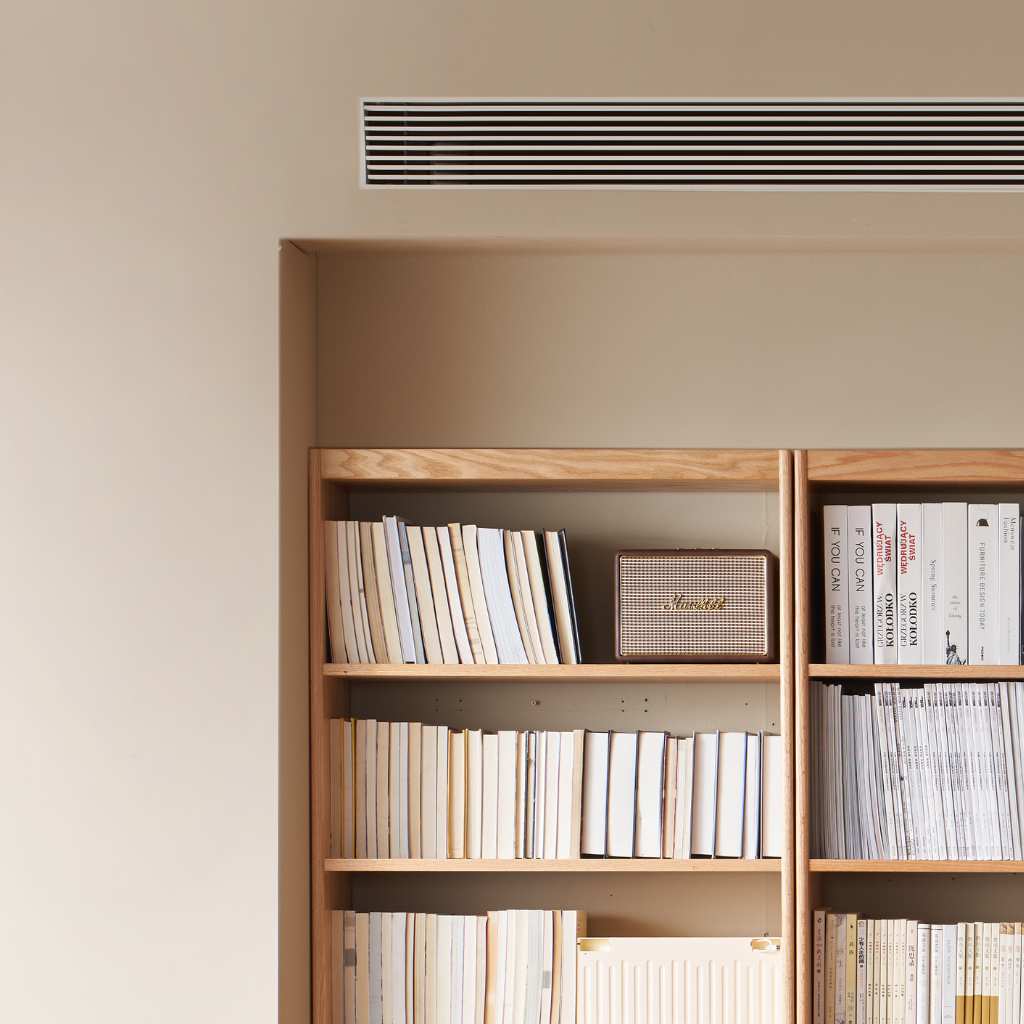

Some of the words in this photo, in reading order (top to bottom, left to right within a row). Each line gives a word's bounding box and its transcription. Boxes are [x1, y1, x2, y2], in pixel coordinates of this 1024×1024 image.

[831, 527, 840, 536] IF
[855, 527, 864, 536] IF
[831, 541, 840, 564] YOU
[855, 542, 864, 564] YOU
[884, 534, 892, 562] ŚWIAT
[831, 568, 840, 592] CAN
[855, 568, 864, 592] CAN
[930, 559, 938, 582] Spring
